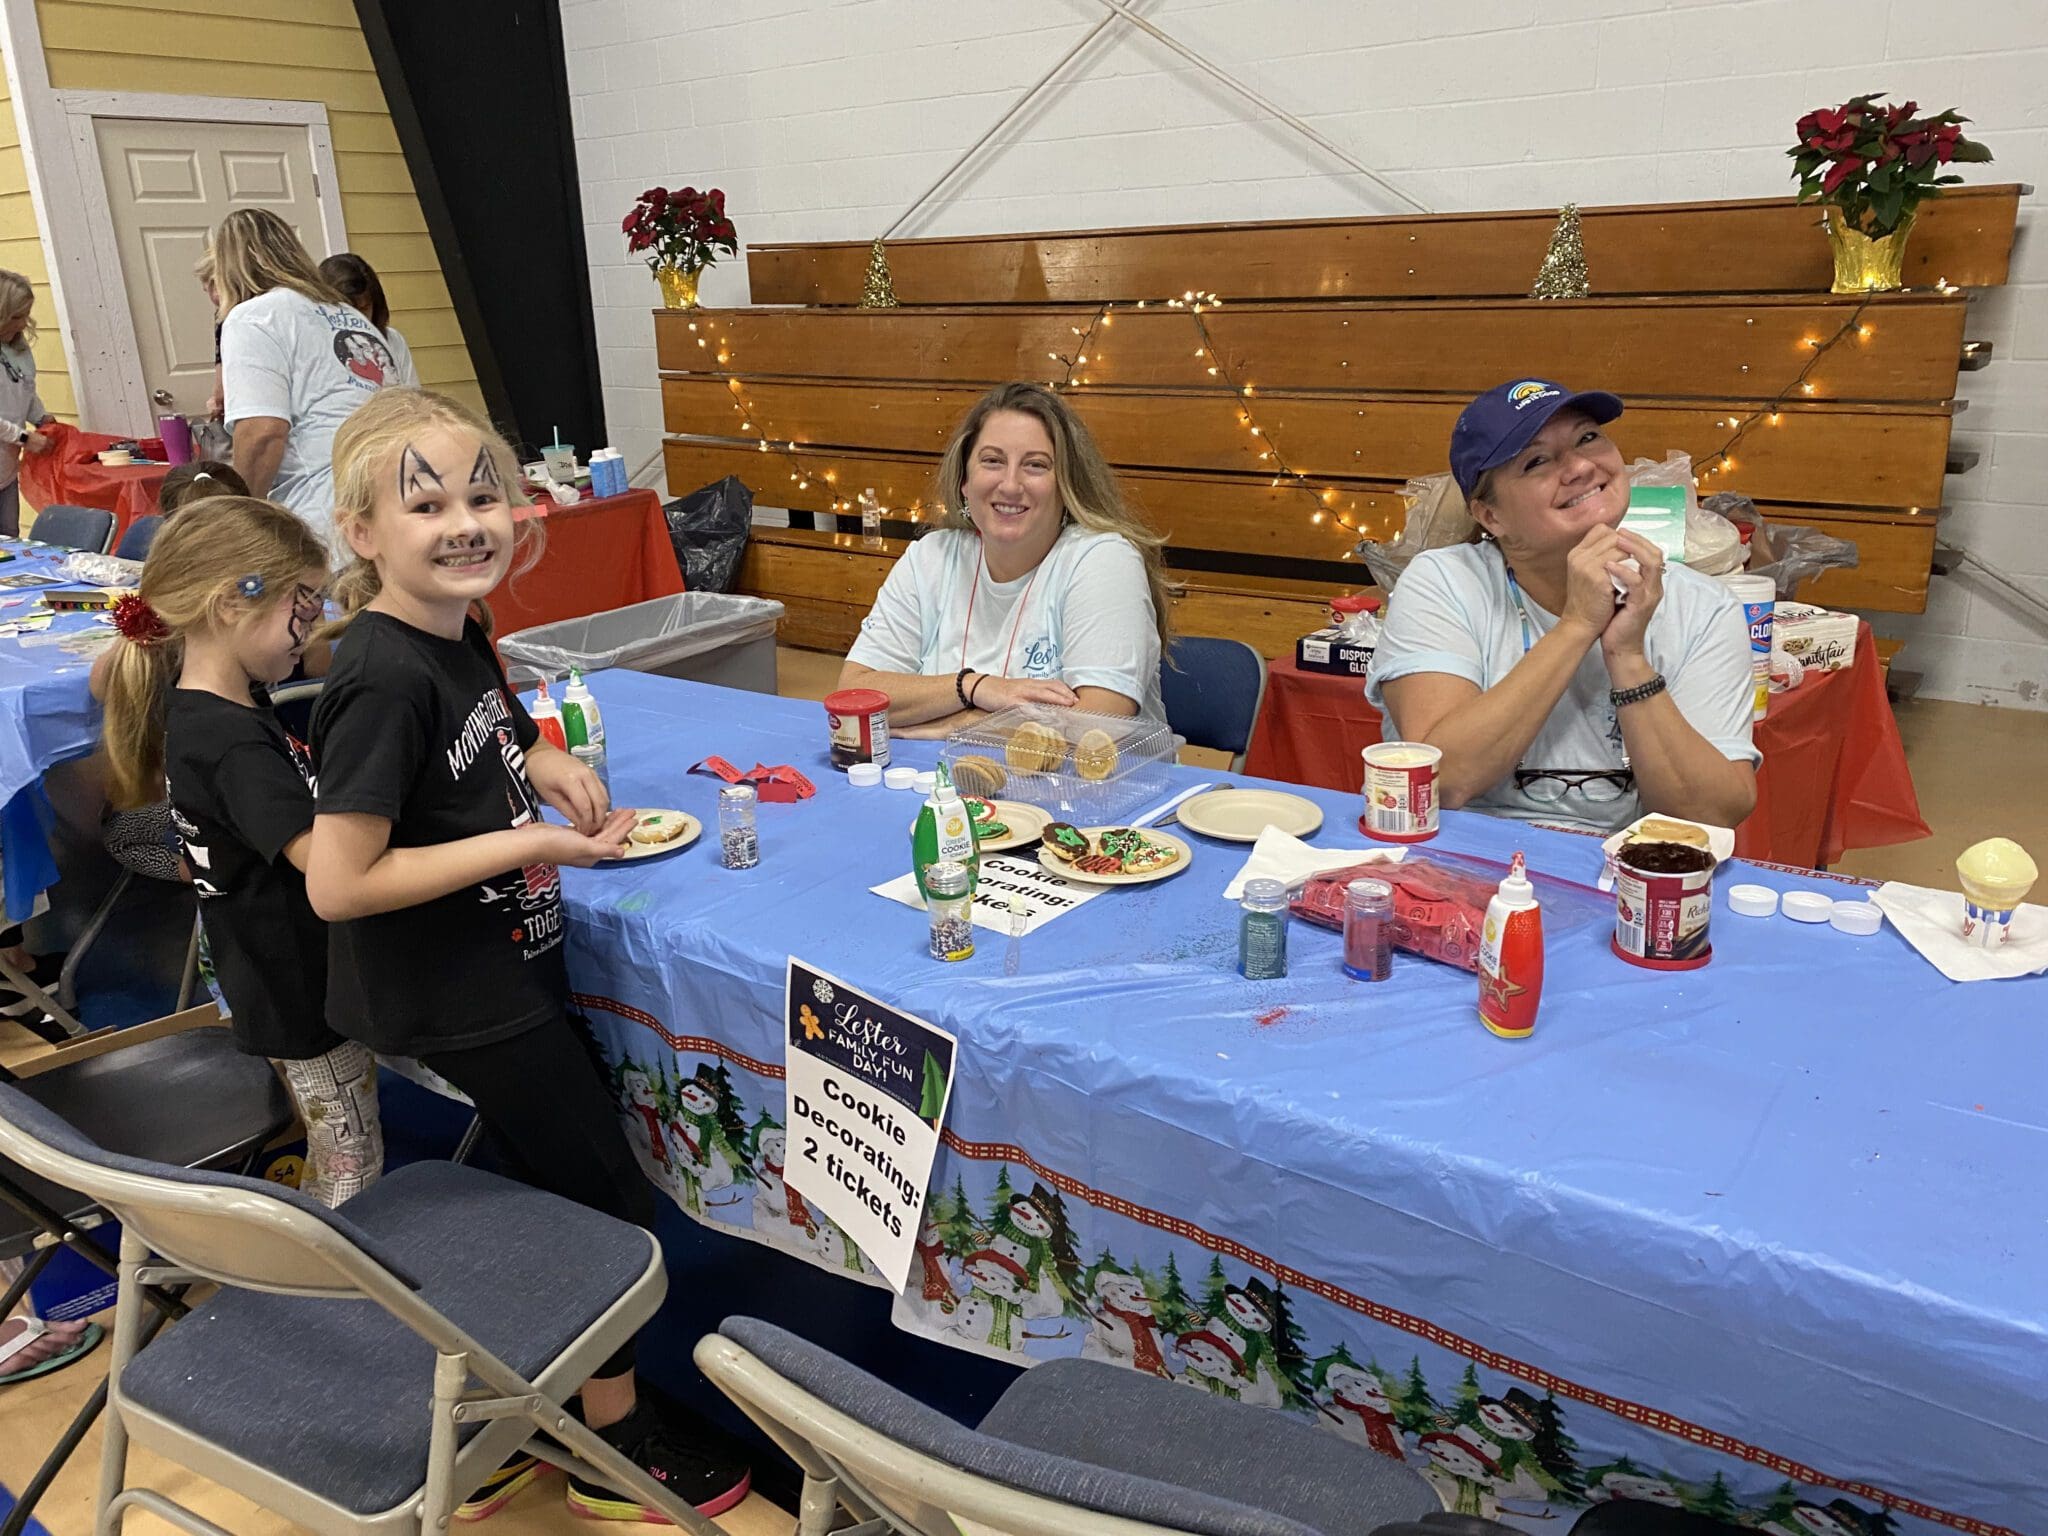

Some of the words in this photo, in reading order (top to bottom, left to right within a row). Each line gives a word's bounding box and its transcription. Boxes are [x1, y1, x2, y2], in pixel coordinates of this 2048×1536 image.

[1340, 648, 1372, 662] DISPOS
[1349, 662, 1367, 674] GLO
[446, 701, 494, 781] MOVING
[941, 840, 971, 855] COOKIE
[983, 860, 1068, 887] Cookie
[977, 877, 1075, 908] orating:
[523, 903, 561, 942] TOGE
[834, 1003, 908, 1056] Lester
[853, 1055, 888, 1083] DAY!
[882, 1056, 913, 1083] FUN
[823, 1078, 906, 1146] Cookie
[794, 1094, 920, 1209] Decorating:
[803, 1136, 818, 1164] 2
[826, 1153, 902, 1238] tickets
